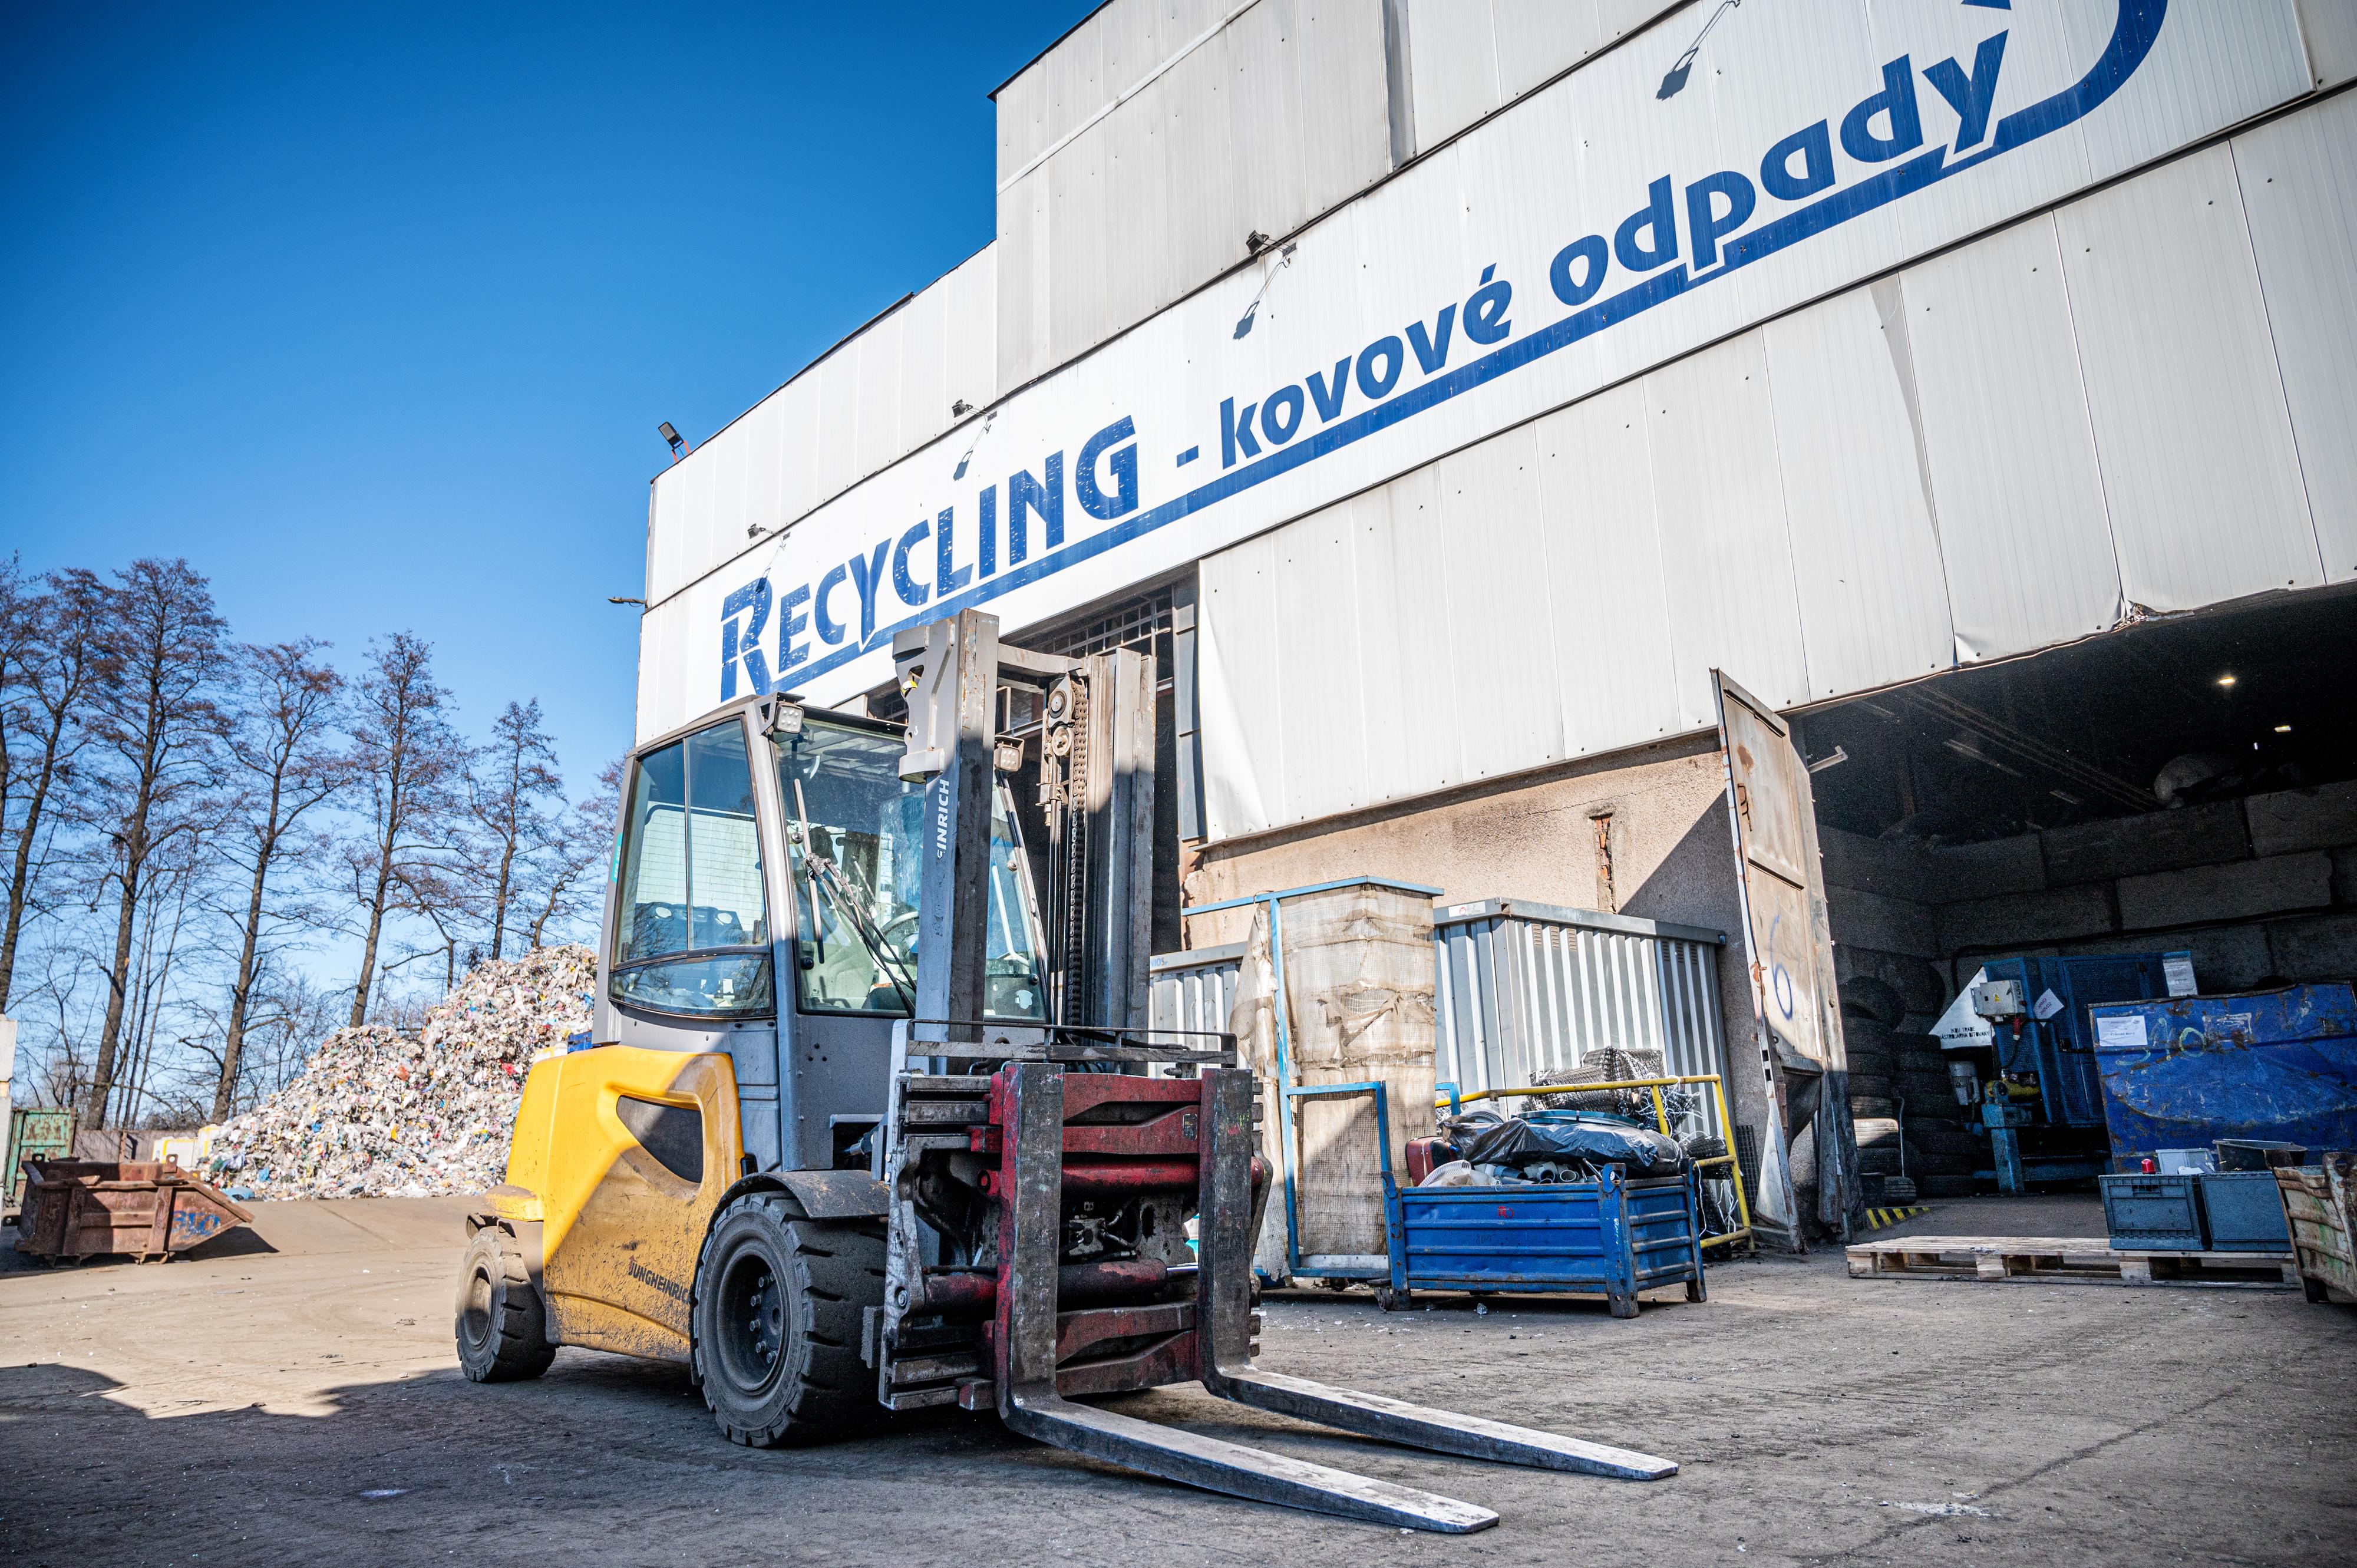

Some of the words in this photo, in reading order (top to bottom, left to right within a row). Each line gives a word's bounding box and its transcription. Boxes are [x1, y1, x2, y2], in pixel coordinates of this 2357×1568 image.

[721, 416, 1138, 702] RECYCLING
[1220, 262, 1512, 470] kovové
[1550, 31, 2009, 306] odpady
[1770, 915, 1792, 1021] 6
[628, 1262, 693, 1305] JUNGHEINRIC
